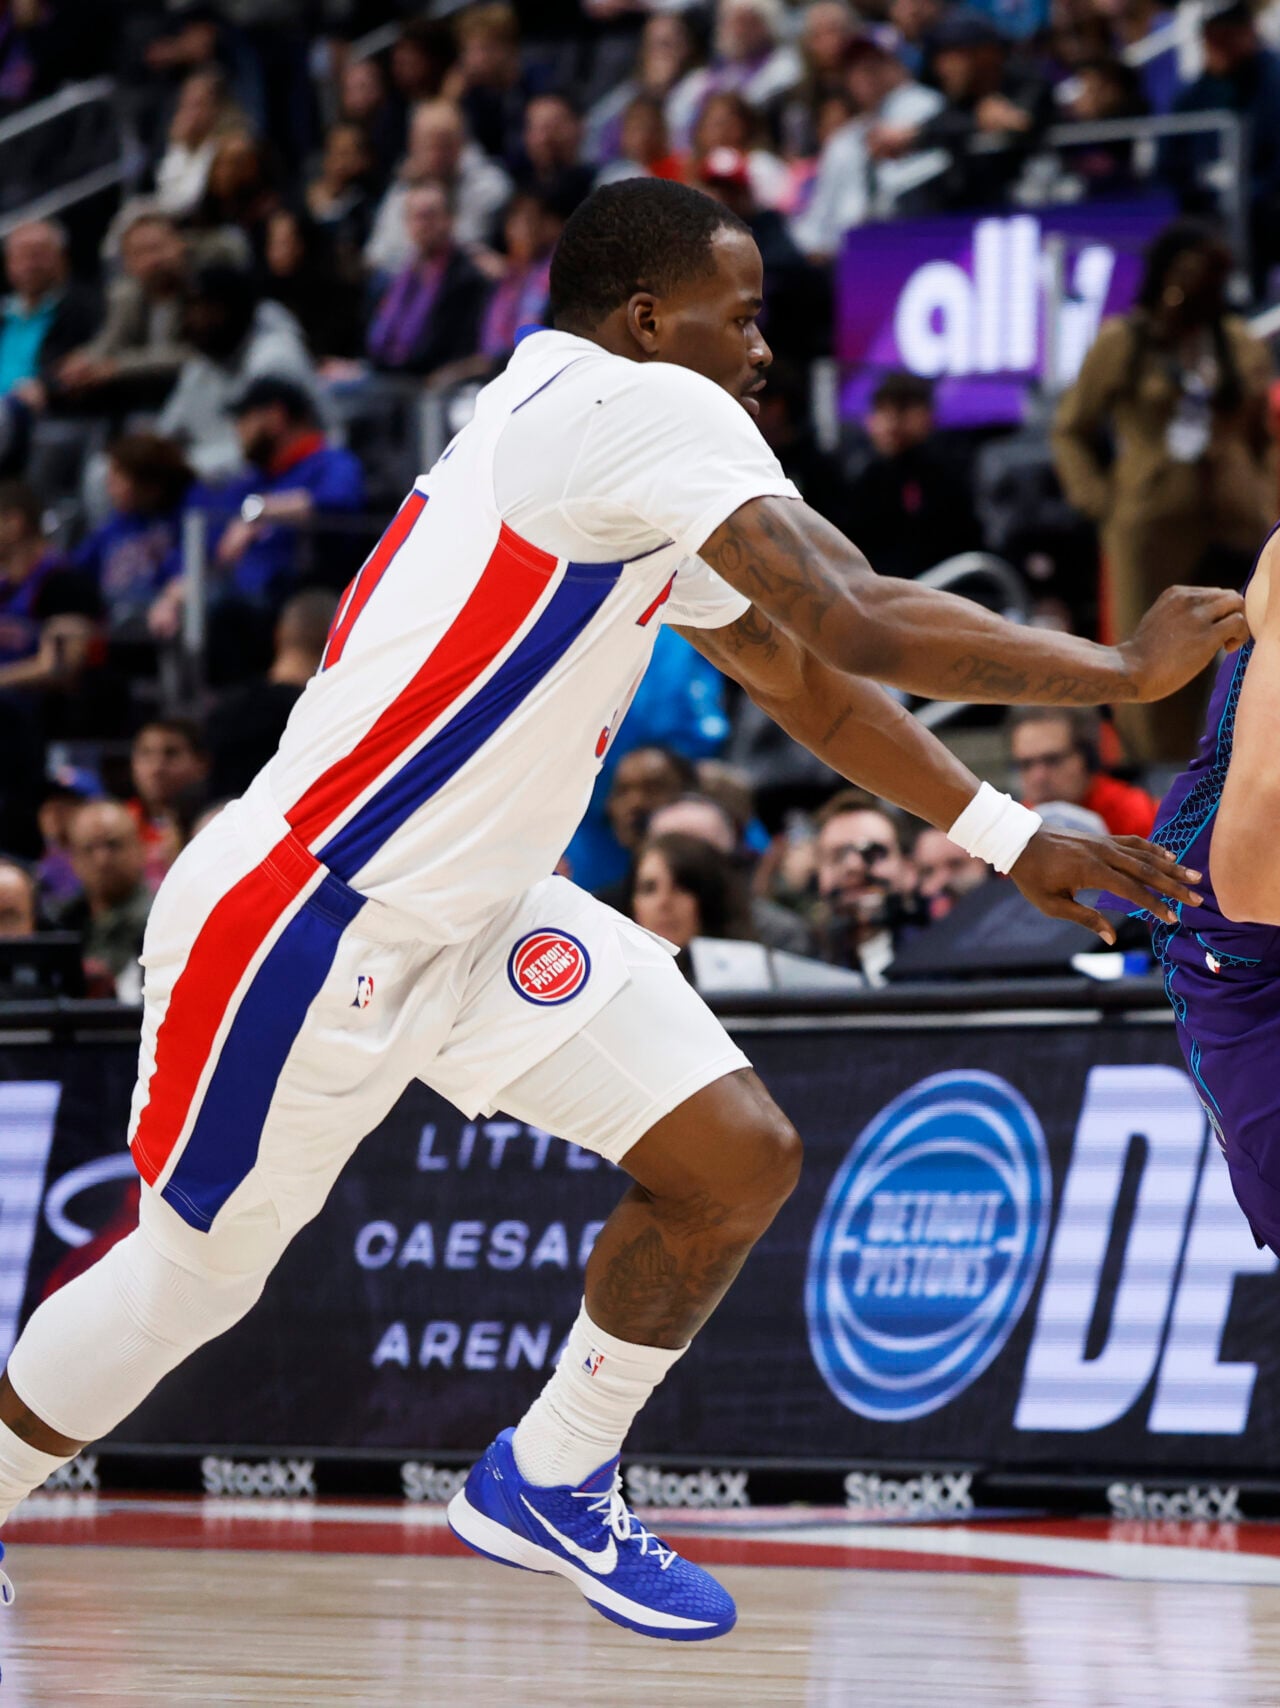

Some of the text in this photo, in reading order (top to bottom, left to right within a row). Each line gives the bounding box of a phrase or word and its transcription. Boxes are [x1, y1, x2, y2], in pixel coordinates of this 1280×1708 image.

[522, 942, 566, 981] DETROIT
[531, 951, 576, 991] PISTONS
[201, 1456, 316, 1497] StockX
[626, 1465, 748, 1507] StockX
[844, 1472, 975, 1512] StockX
[1106, 1482, 1242, 1522] StockX
